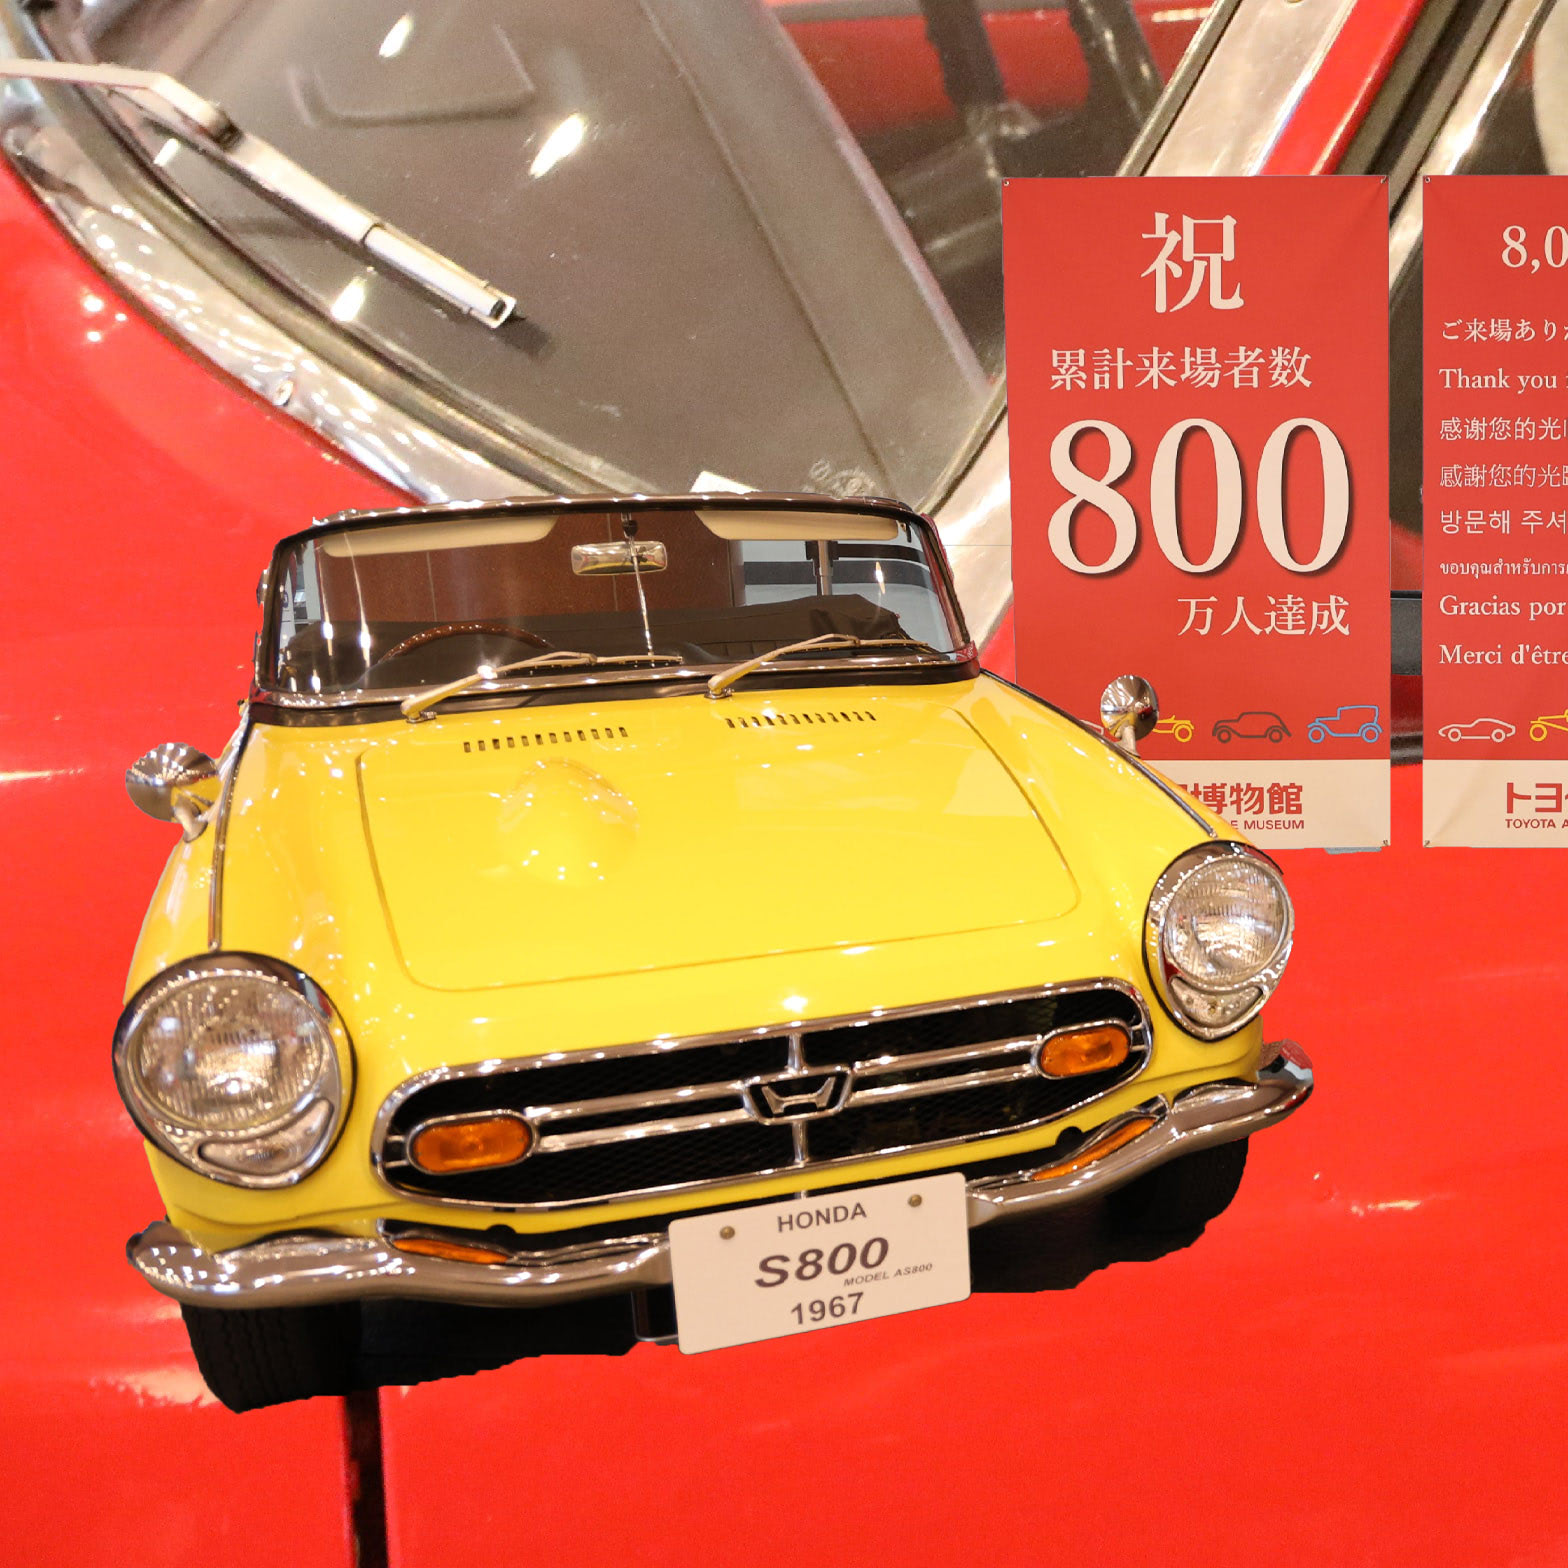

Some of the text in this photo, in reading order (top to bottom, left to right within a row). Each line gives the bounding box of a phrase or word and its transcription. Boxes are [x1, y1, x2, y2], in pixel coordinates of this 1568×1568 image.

[1140, 211, 1245, 314] 祝
[1049, 346, 1313, 391] 累計来場者数
[1438, 368, 1510, 389] Thank
[1517, 375, 1558, 394] you
[1047, 417, 1352, 576] 800
[1440, 509, 1511, 535] 방문해
[1177, 594, 1350, 636] 万人達成
[1439, 594, 1521, 616] Gracias
[1528, 600, 1567, 621] por
[1439, 644, 1502, 665] Merci
[1178, 782, 1303, 815] 博物館
[1243, 819, 1305, 830] MUSEUM
[1505, 818, 1557, 829] TOYOTA
[776, 1202, 868, 1233] HONDA
[754, 1237, 890, 1289] S800
[843, 1263, 933, 1287] MODEL AS800
[790, 1292, 864, 1326] 1967
